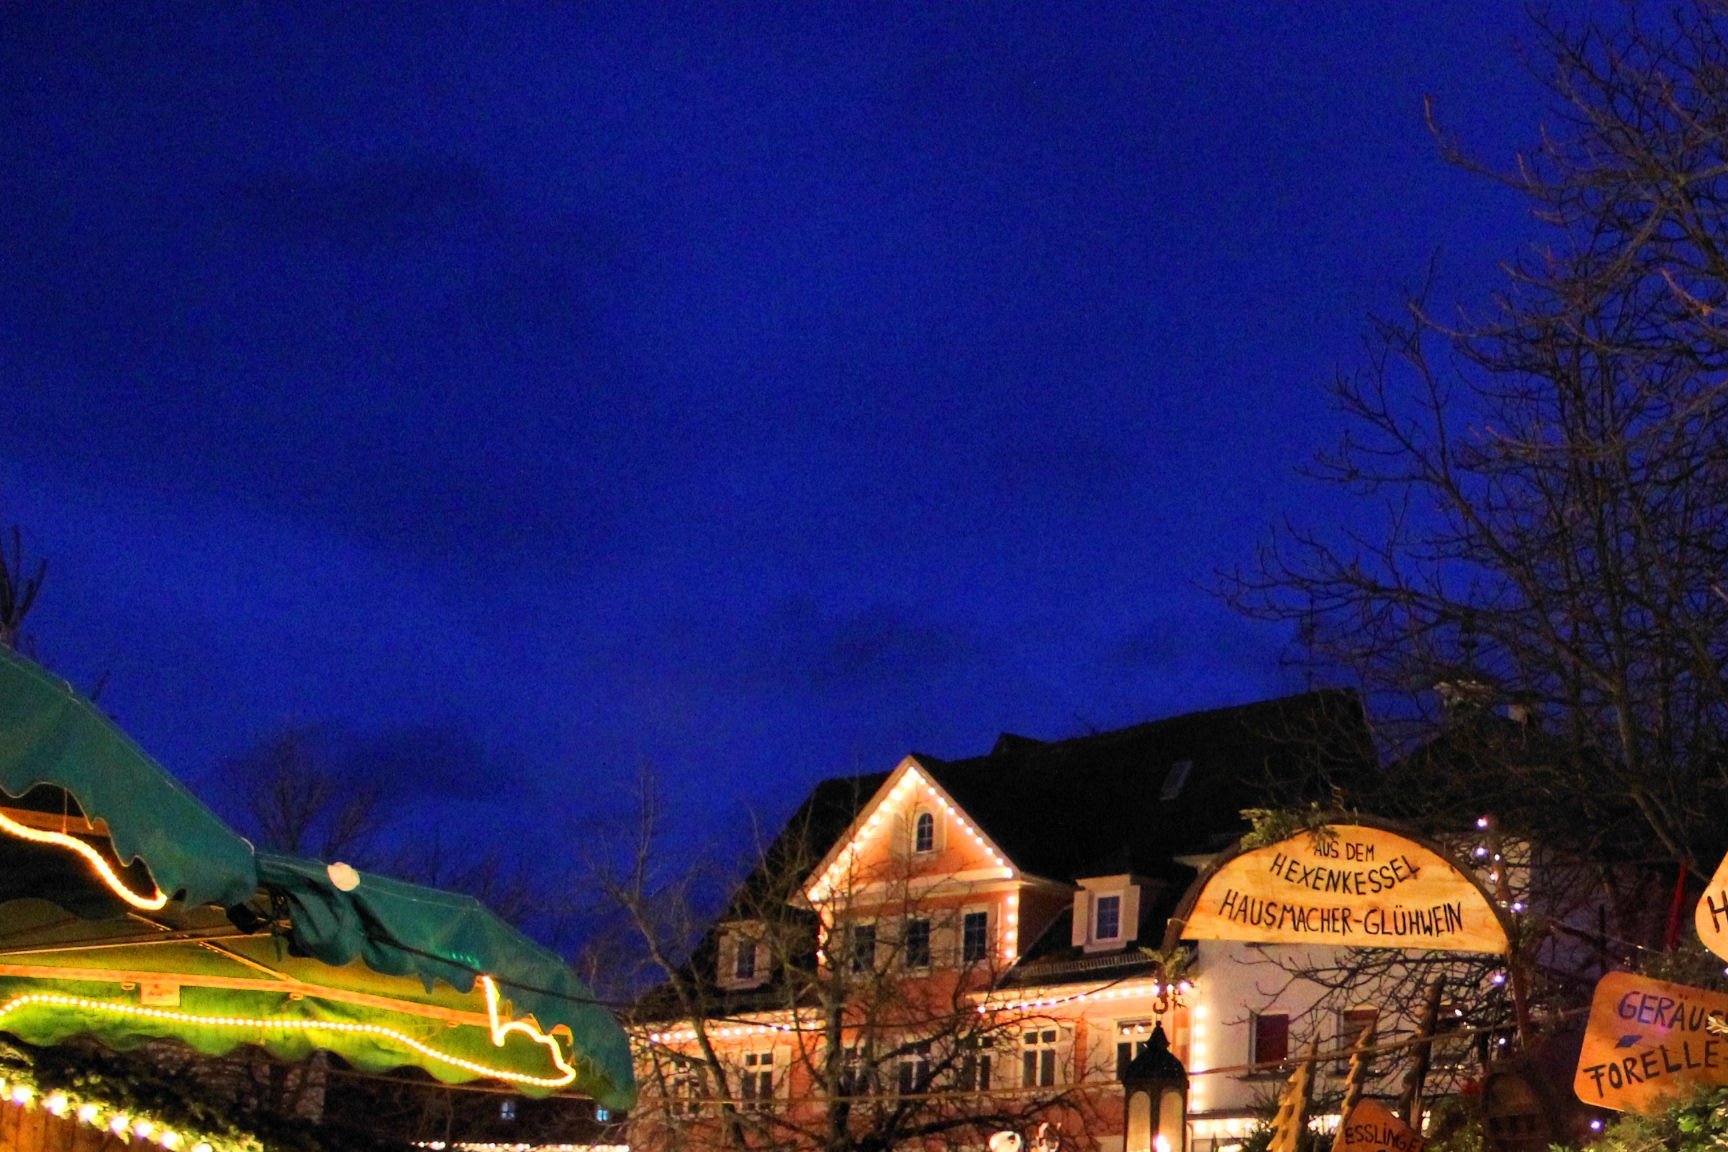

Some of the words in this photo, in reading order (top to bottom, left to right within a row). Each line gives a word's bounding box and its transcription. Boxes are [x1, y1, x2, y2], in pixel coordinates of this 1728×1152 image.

[1313, 840, 1340, 859] AUS
[1346, 842, 1375, 861] DEM
[1269, 852, 1421, 895] HEXENKESSEL
[1218, 889, 1463, 937] HAUSMACHER-GLÜHWEIN
